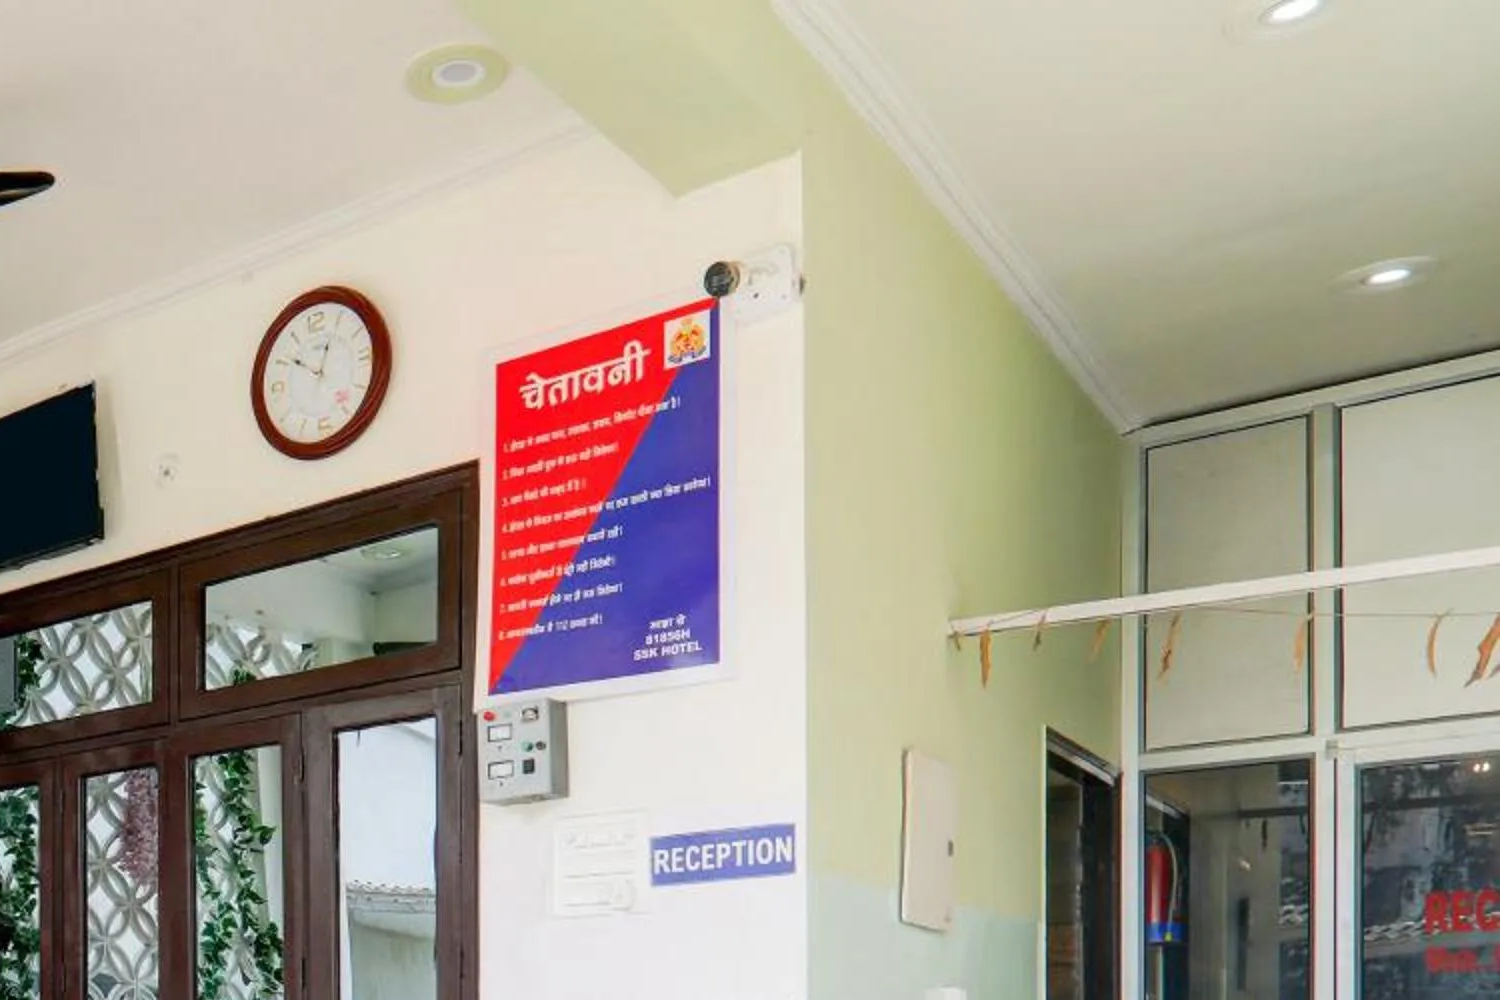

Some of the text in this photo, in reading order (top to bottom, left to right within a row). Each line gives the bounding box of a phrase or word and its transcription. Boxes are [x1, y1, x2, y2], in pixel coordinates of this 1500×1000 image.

[519, 339, 652, 410] चेतावनी
[661, 640, 702, 656] HOTEL
[653, 837, 792, 874] RECEPTION
